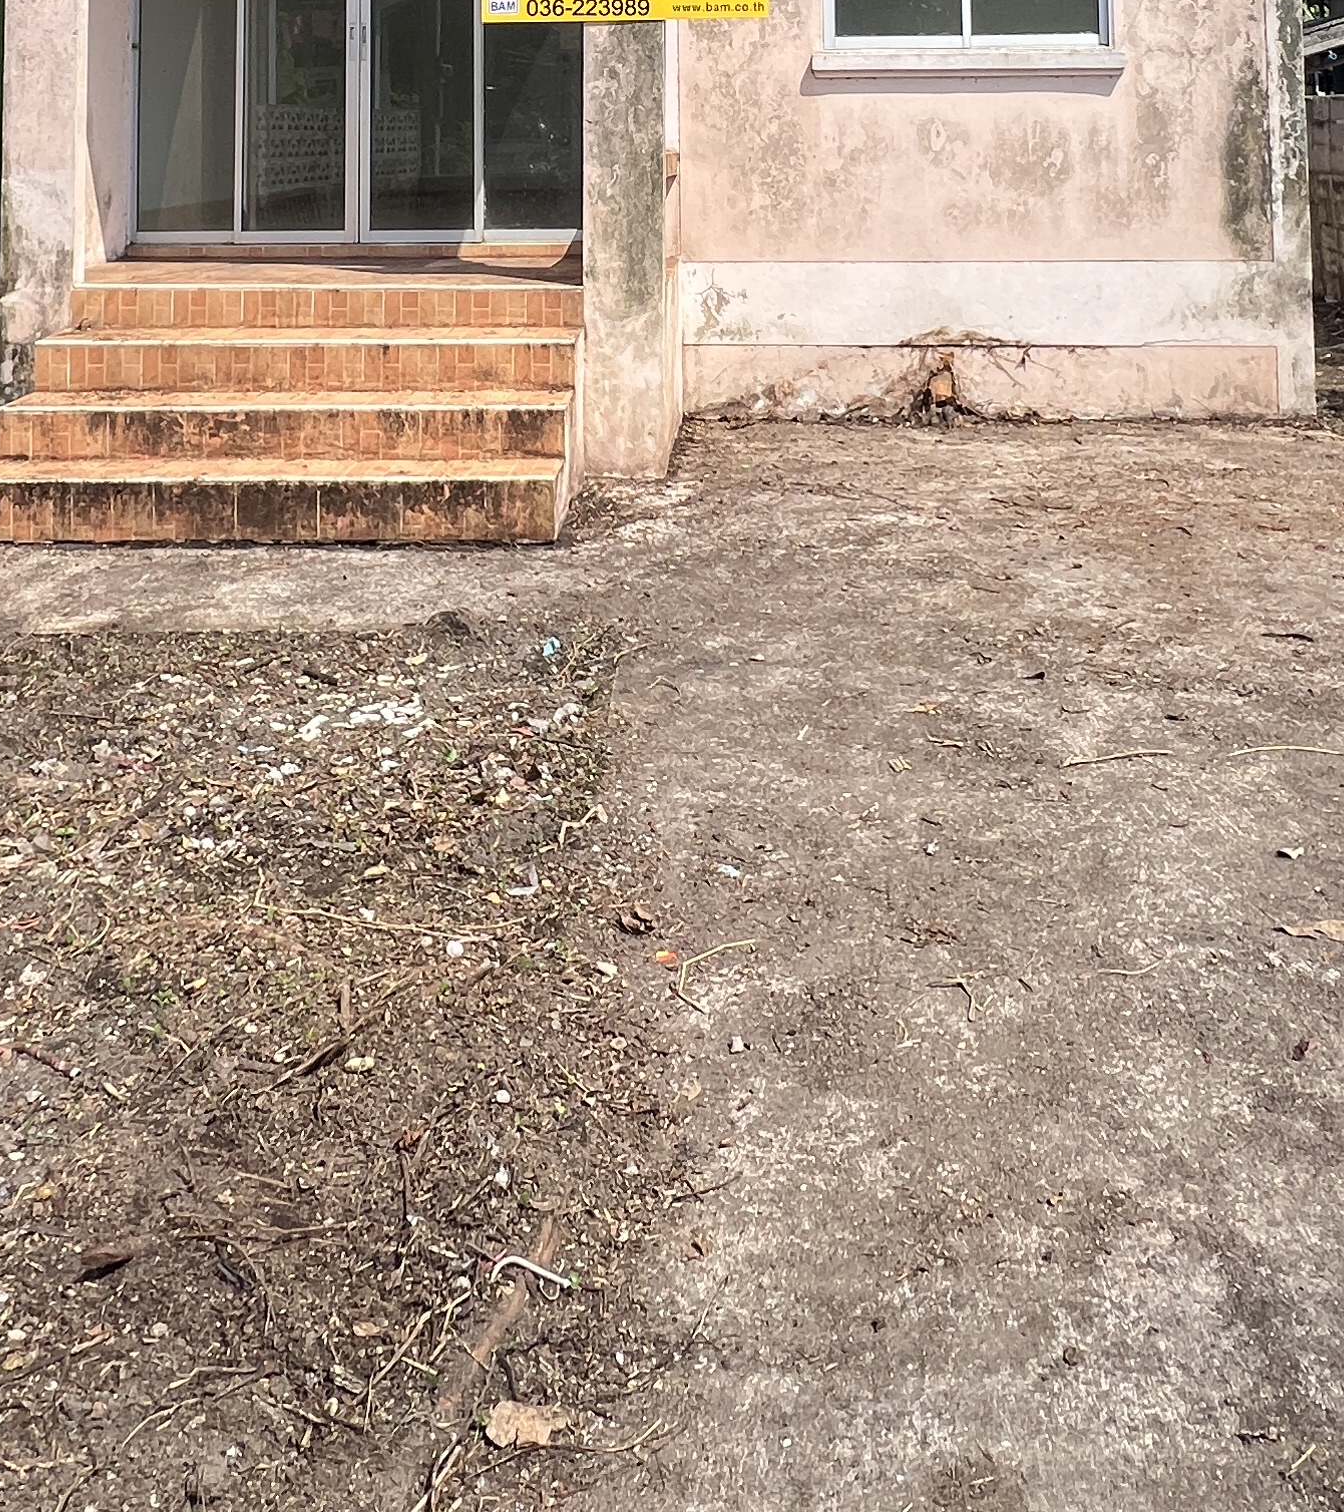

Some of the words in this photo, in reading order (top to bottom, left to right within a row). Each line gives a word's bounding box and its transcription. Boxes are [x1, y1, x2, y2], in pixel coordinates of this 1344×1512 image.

[491, 1, 516, 12] BAM
[526, 0, 650, 17] 036-223989
[672, 1, 765, 13] www.bam.co.th
